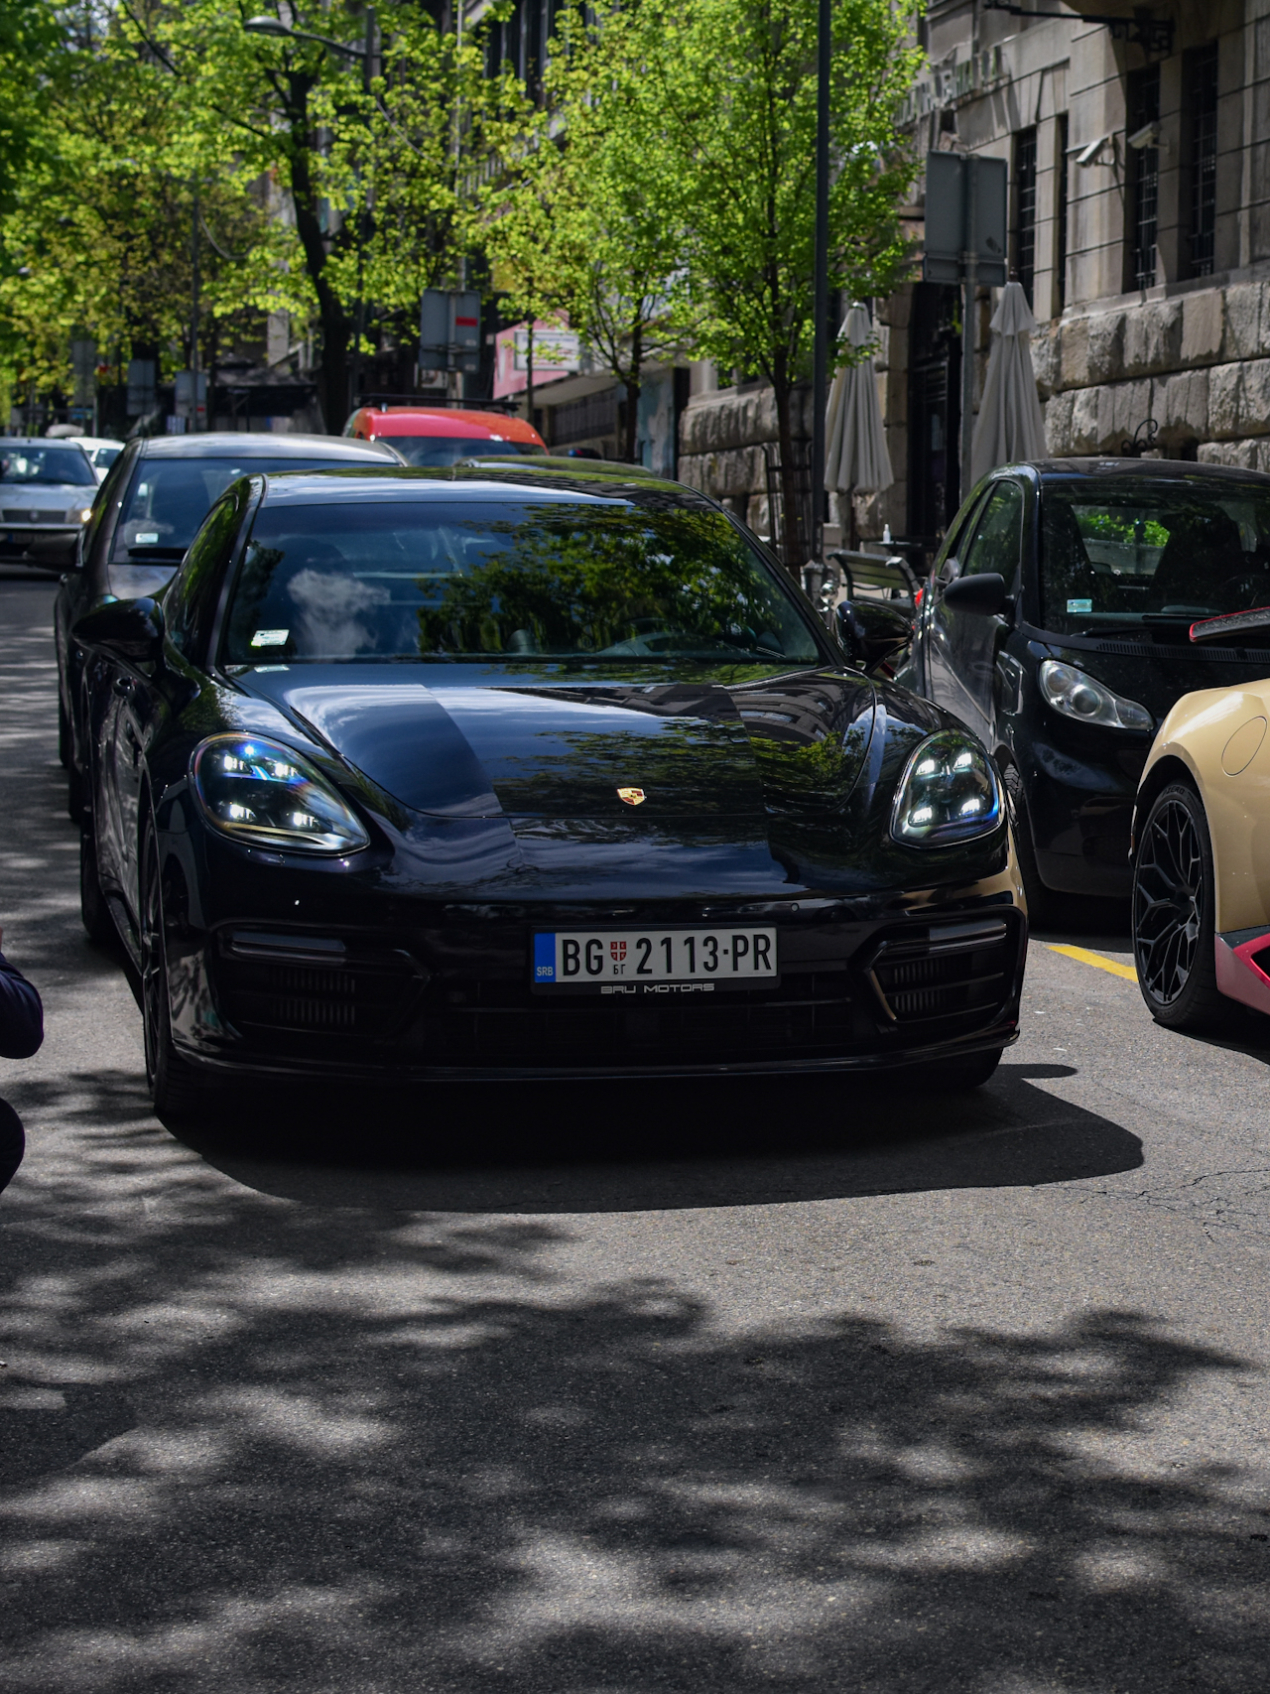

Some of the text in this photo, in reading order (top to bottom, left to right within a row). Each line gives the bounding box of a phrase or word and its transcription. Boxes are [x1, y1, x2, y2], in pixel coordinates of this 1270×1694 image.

[536, 966, 554, 977] SRB
[562, 939, 604, 976] BG
[601, 983, 715, 995] BRU MOTORS
